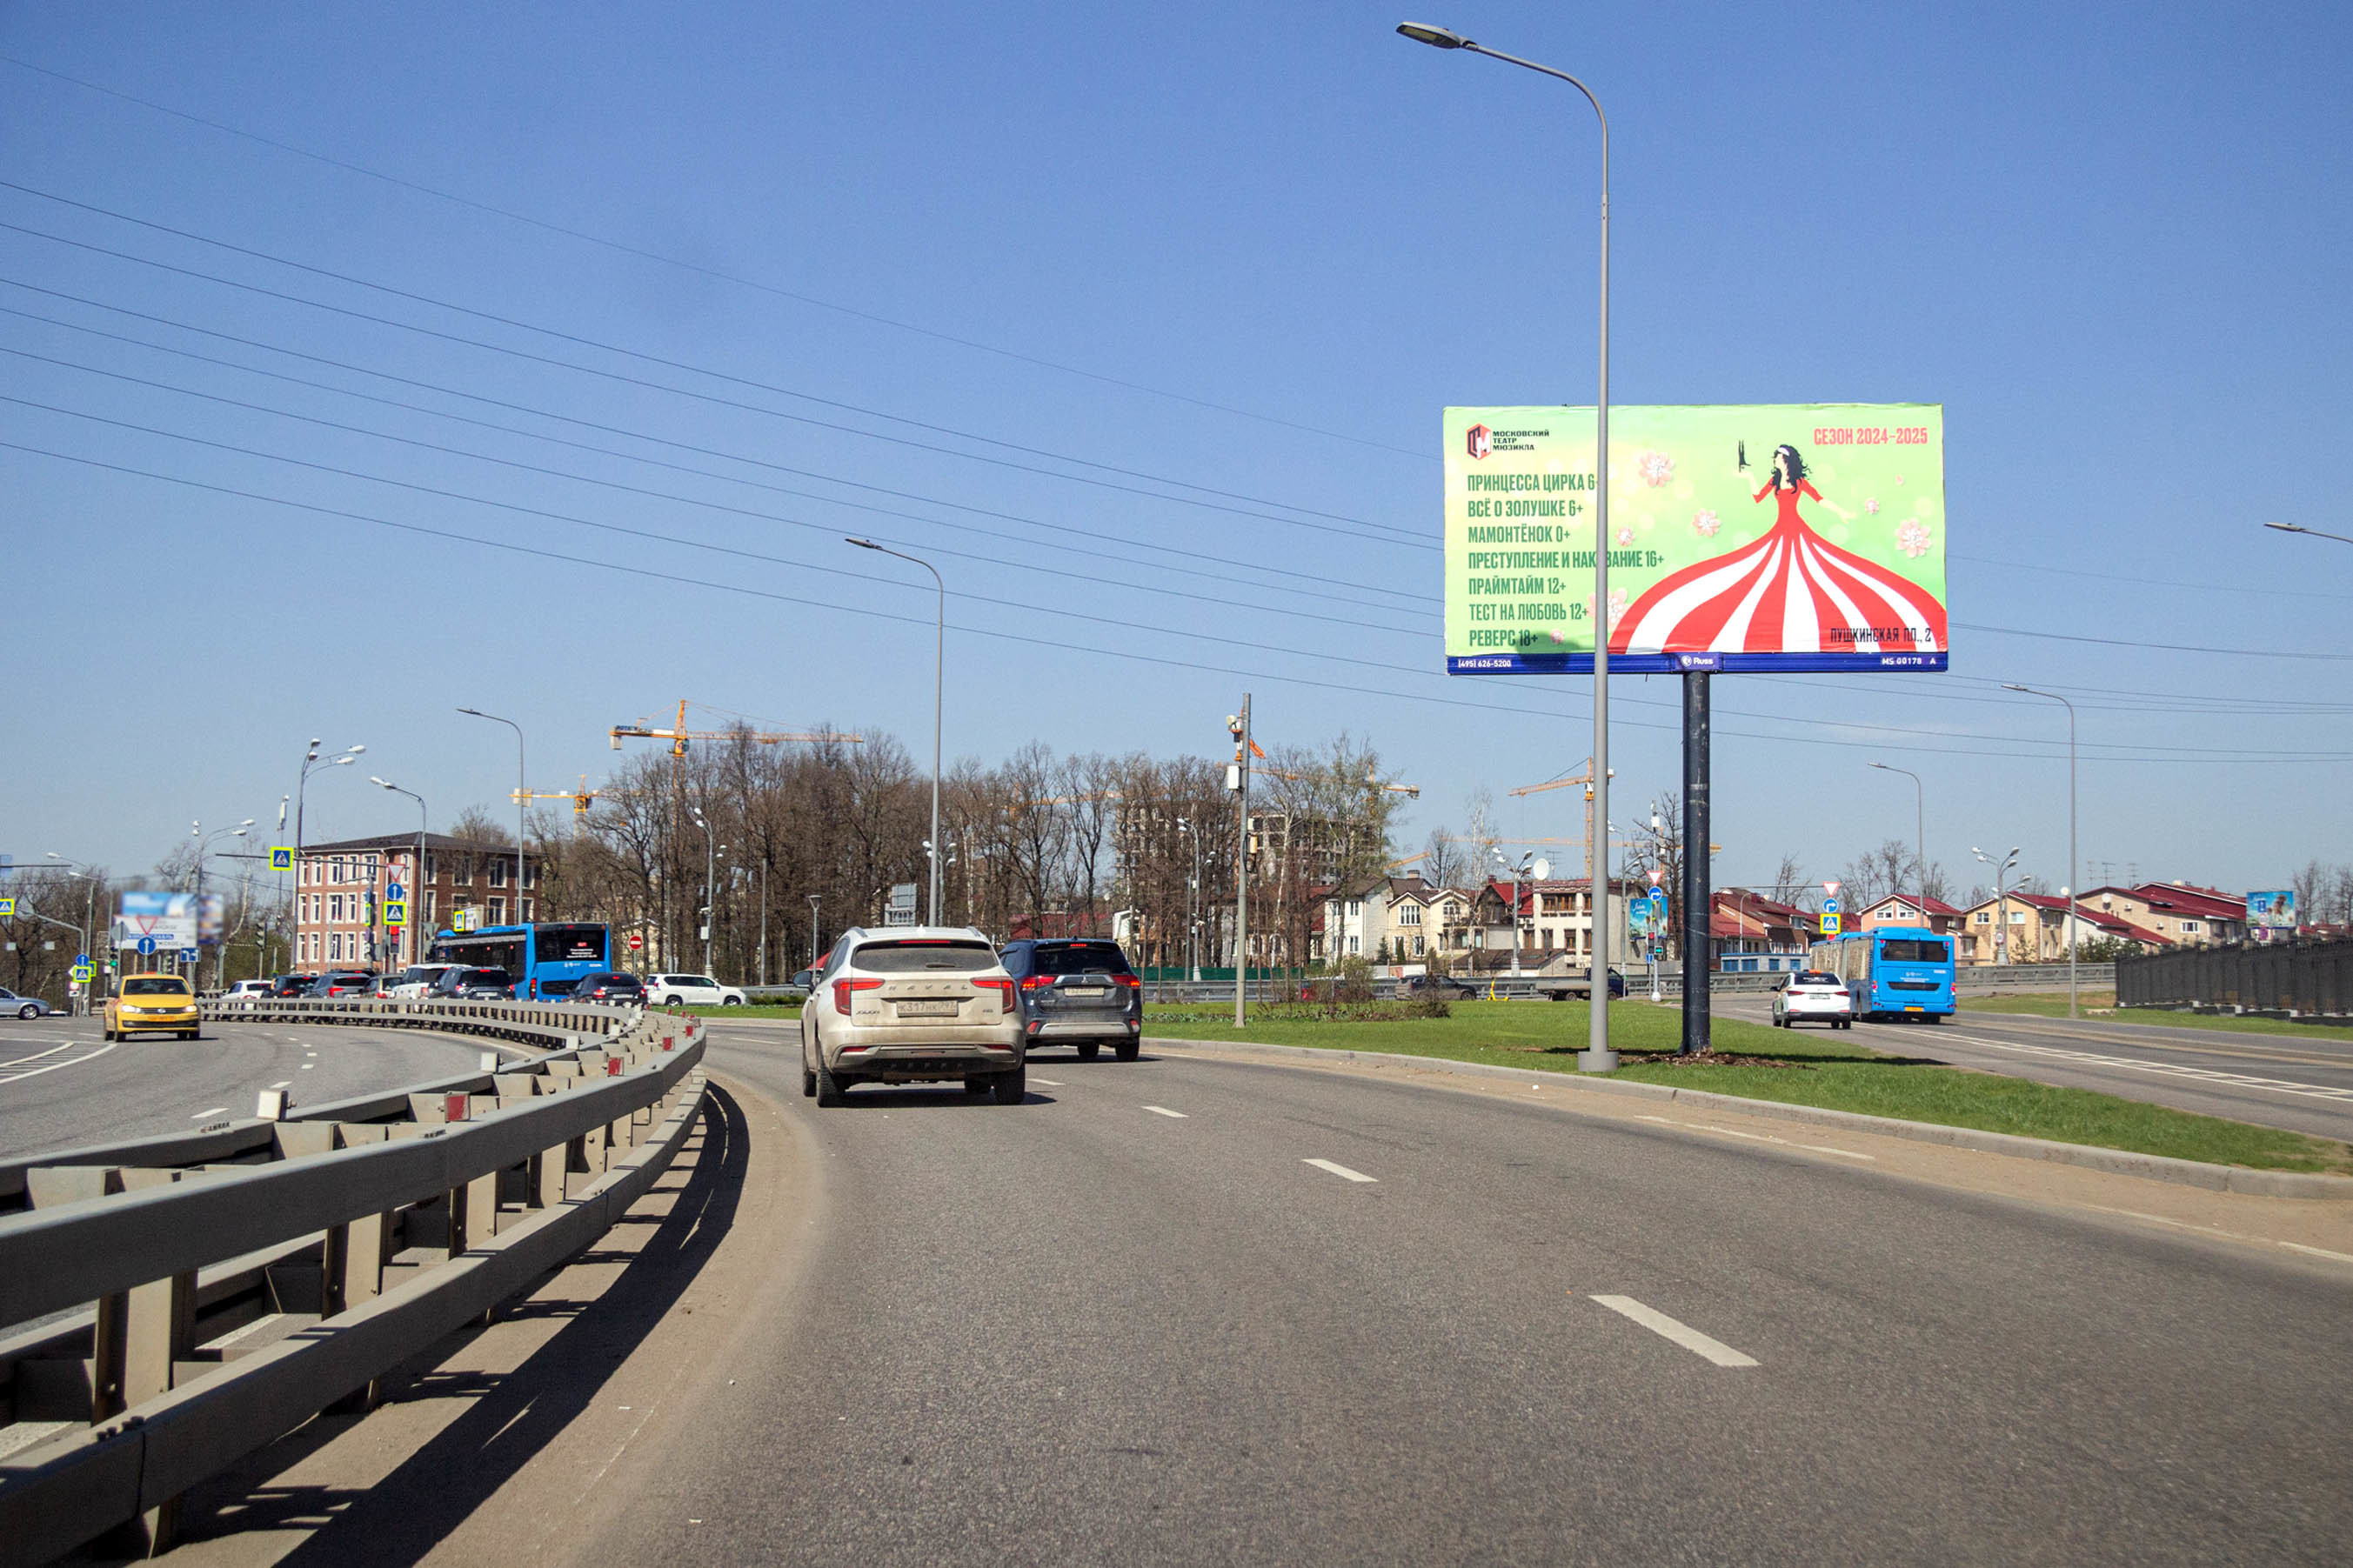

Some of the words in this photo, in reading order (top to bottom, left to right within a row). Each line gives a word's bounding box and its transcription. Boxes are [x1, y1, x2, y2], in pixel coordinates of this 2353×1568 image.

[1814, 428, 1853, 445] СЕЗОН
[1856, 427, 1929, 445] 2024-2025
[1467, 474, 1540, 493] ПРИНЦЕССА
[1543, 473, 1585, 492] ЦИРКА
[1588, 473, 1599, 490] 6
[1467, 497, 1491, 517] ВСЁ
[1494, 500, 1502, 517] О
[1505, 499, 1566, 517] ЗОЛУШКЕ
[1568, 499, 1583, 517] 6+
[1467, 523, 1552, 544] МАМОНТЁНОК
[1555, 525, 1570, 542] 0+
[1467, 551, 1559, 569] ПРЕСТУПЛЕНИЕ
[1561, 551, 1569, 568] И
[1573, 550, 1642, 568] НАКЗАНИЕ
[1645, 550, 1664, 567] 16+
[1468, 575, 1544, 595] ПРАЙМТАЙМ
[1547, 577, 1566, 594] 12+
[1469, 604, 1496, 620] ТЕСТ
[1501, 604, 1515, 620] НА
[1518, 604, 1567, 620] ЛЮБОВЬ
[1570, 603, 1588, 619] 12+
[1469, 630, 1515, 647] РЕВЕРС
[1520, 630, 1538, 646] 18+
[1830, 628, 1899, 643] ПУШКИНСКАЯ
[1925, 628, 1932, 642] 2
[1478, 659, 1512, 668] 626-5200
